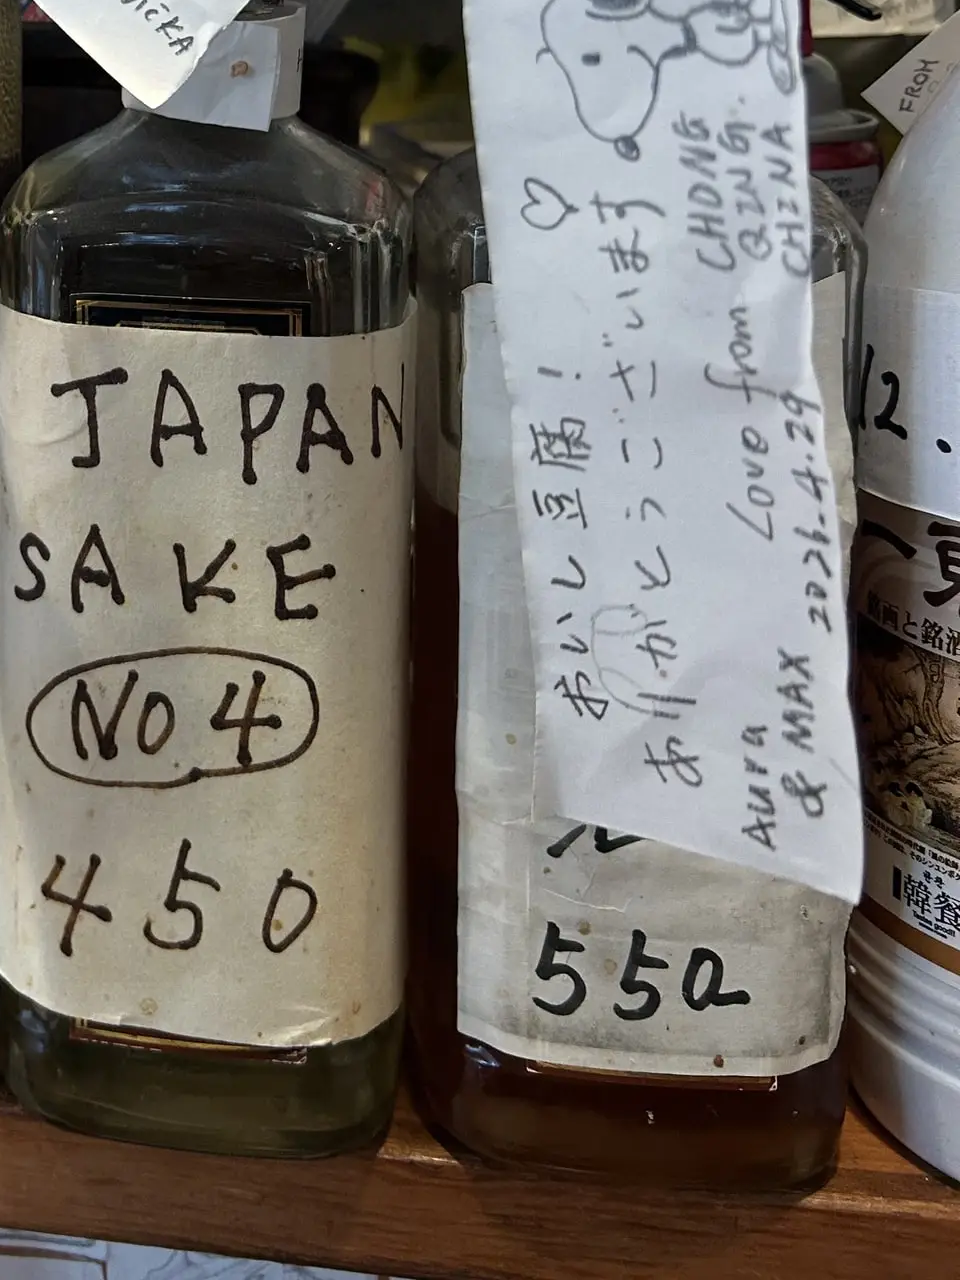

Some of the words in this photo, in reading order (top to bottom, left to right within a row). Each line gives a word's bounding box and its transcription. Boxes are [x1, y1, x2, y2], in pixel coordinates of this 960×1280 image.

[899, 59, 940, 113] FROM
[704, 306, 778, 405] from
[51, 363, 407, 485] JAPAN
[726, 425, 776, 543] Love
[14, 524, 337, 621] SAKE
[777, 648, 819, 755] MAX
[40, 837, 319, 958] 450
